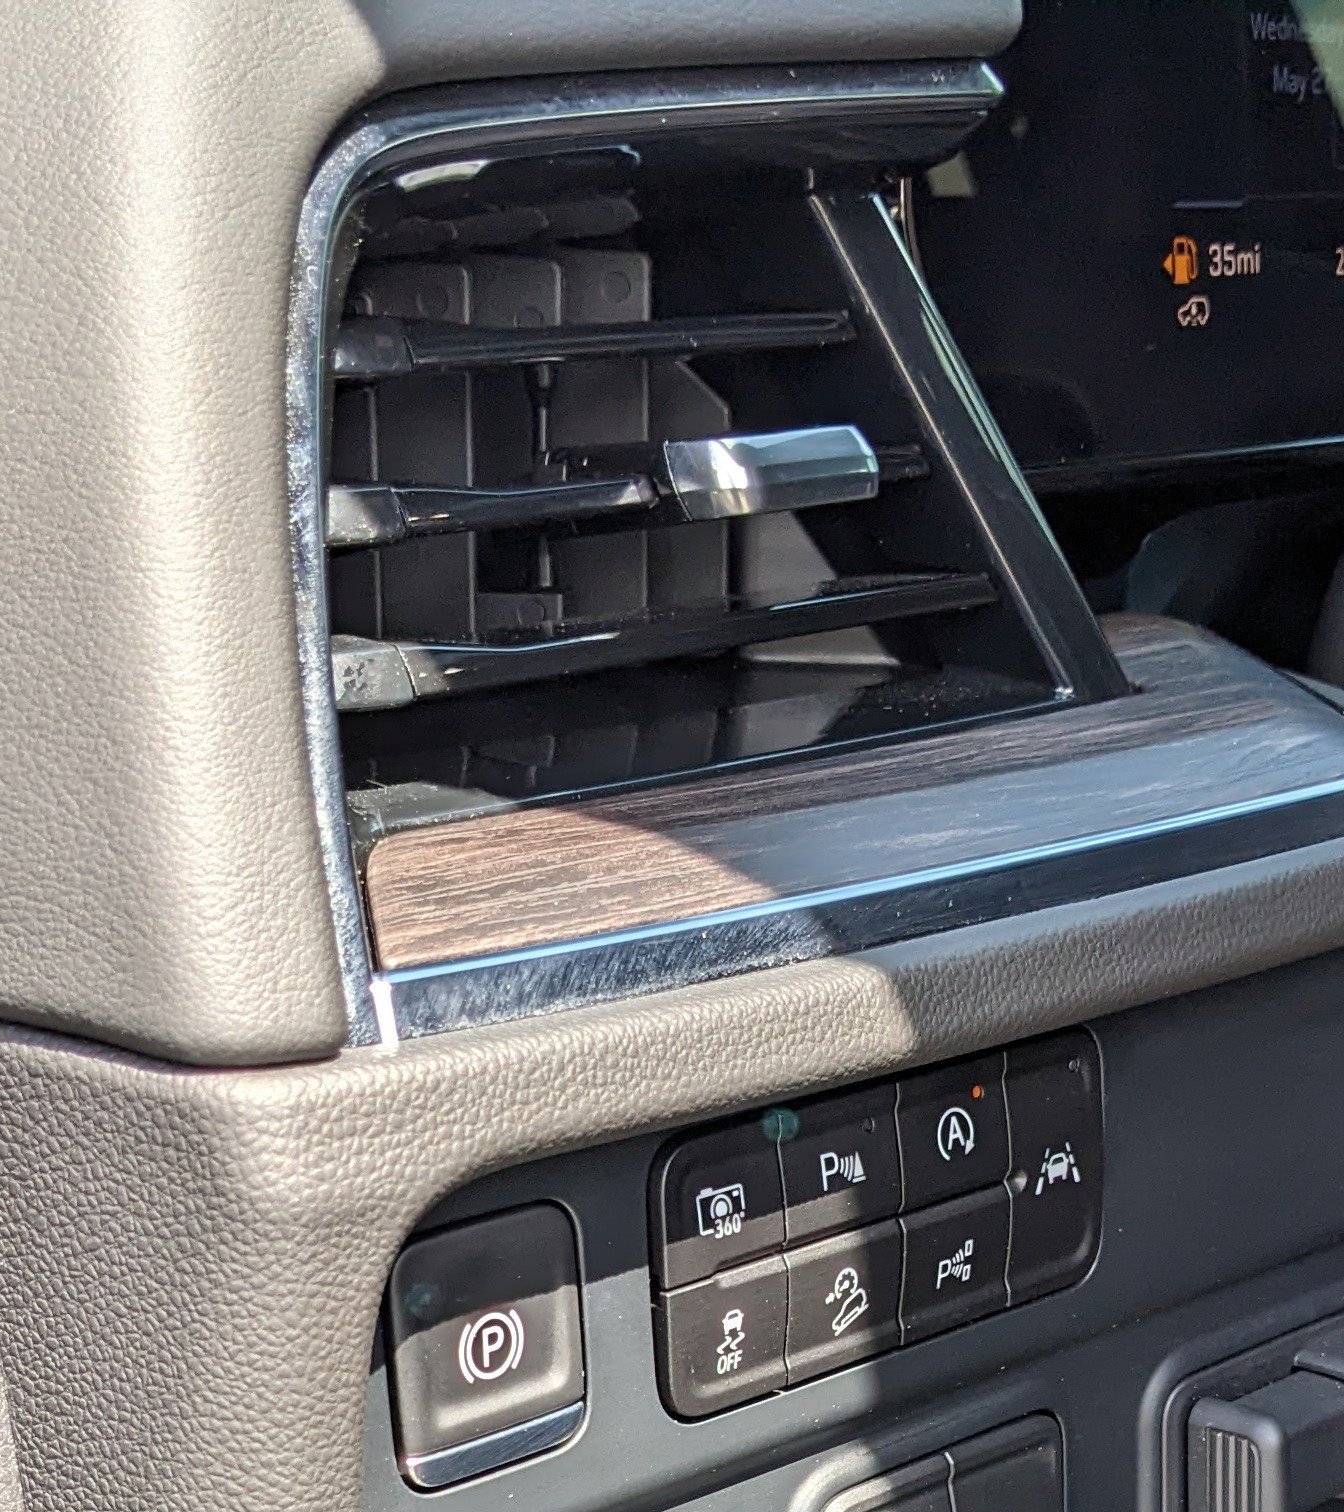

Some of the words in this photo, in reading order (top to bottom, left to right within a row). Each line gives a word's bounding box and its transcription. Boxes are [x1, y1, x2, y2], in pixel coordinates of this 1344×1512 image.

[1272, 64, 1311, 102] May
[820, 1153, 840, 1191] P
[482, 1326, 502, 1368] P
[716, 1351, 743, 1375] OFF
